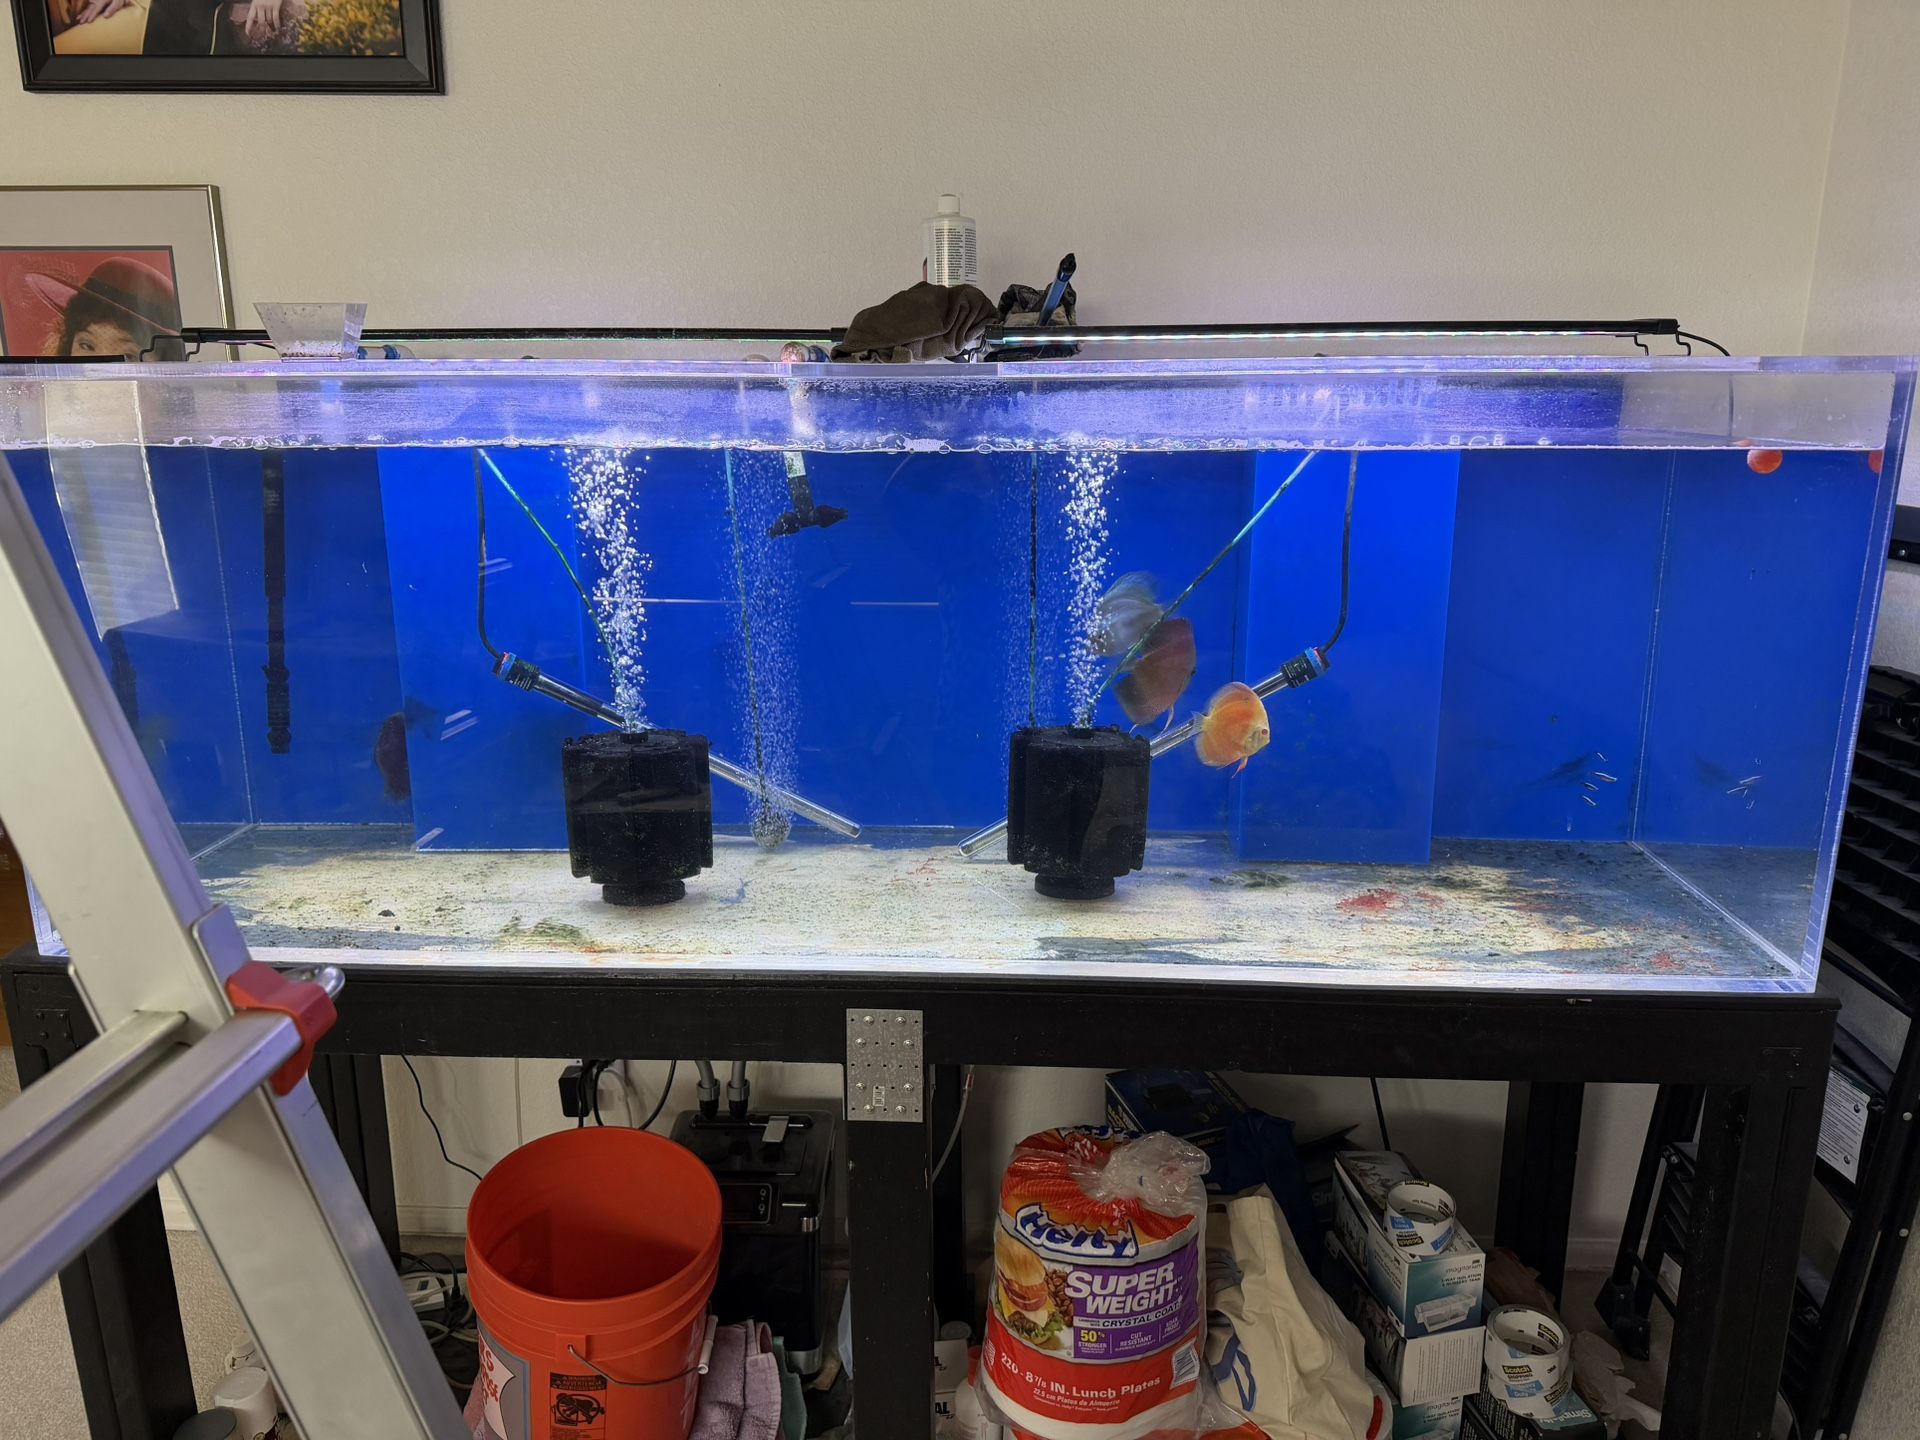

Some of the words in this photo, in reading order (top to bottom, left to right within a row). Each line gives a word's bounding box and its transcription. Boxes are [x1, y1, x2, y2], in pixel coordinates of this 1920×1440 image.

[1064, 1261, 1175, 1298] SUPER
[1085, 1281, 1178, 1314] WEIGHT
[1102, 1316, 1151, 1328] CRYSTAL
[1119, 1335, 1152, 1347] RESISTANT
[1130, 1332, 1143, 1340] CUT
[1504, 1366, 1531, 1374] Scotch
[1000, 1353, 1019, 1375] 220
[1050, 1382, 1070, 1396] IN.
[1072, 1387, 1117, 1400] Lunch
[1121, 1377, 1161, 1396] Plates
[1033, 1388, 1046, 1398] 22.5
